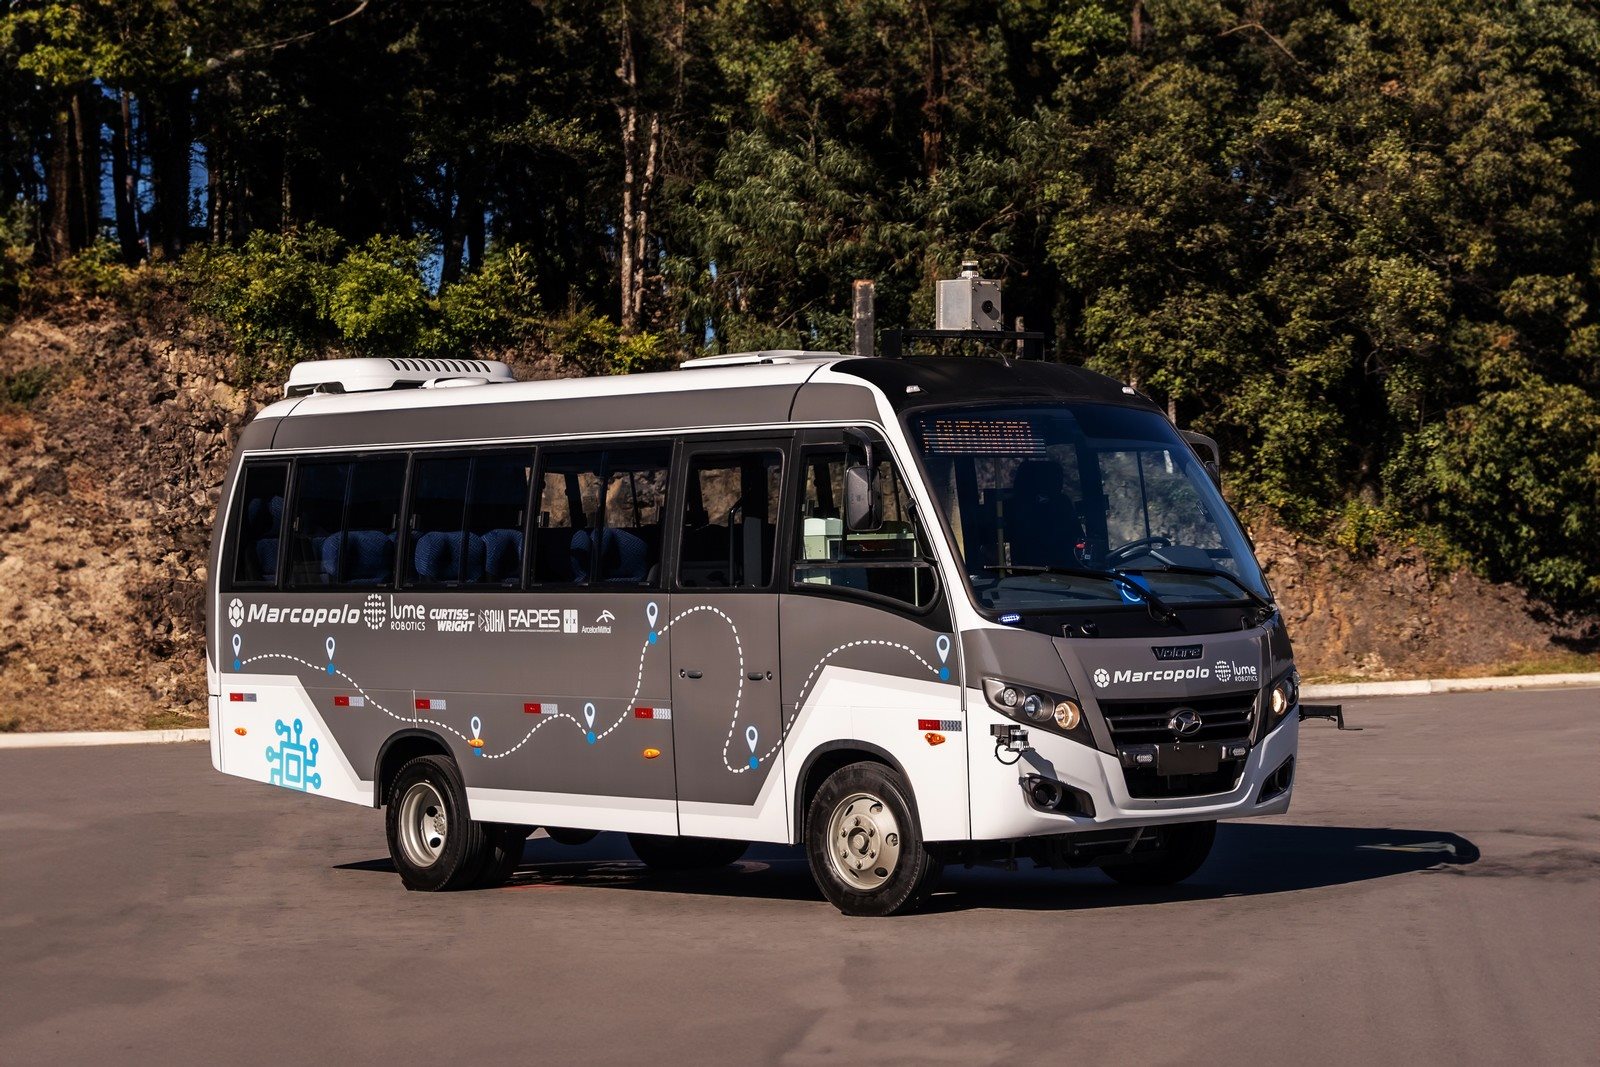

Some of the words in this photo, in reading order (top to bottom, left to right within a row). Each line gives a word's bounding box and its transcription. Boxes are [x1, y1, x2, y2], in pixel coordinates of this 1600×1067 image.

[390, 594, 425, 620] lume
[247, 603, 360, 627] Marcopolo
[484, 609, 506, 632] SOHA
[508, 609, 561, 628] FAPES
[390, 621, 426, 631] ROBOTICS
[437, 620, 475, 632] WRIGHT
[581, 625, 612, 634] ArcelorMittal
[1155, 647, 1201, 658] Volare
[1113, 665, 1210, 684] Marcopolo
[1232, 660, 1257, 675] lume
[1234, 674, 1258, 682] ROBOTICS
